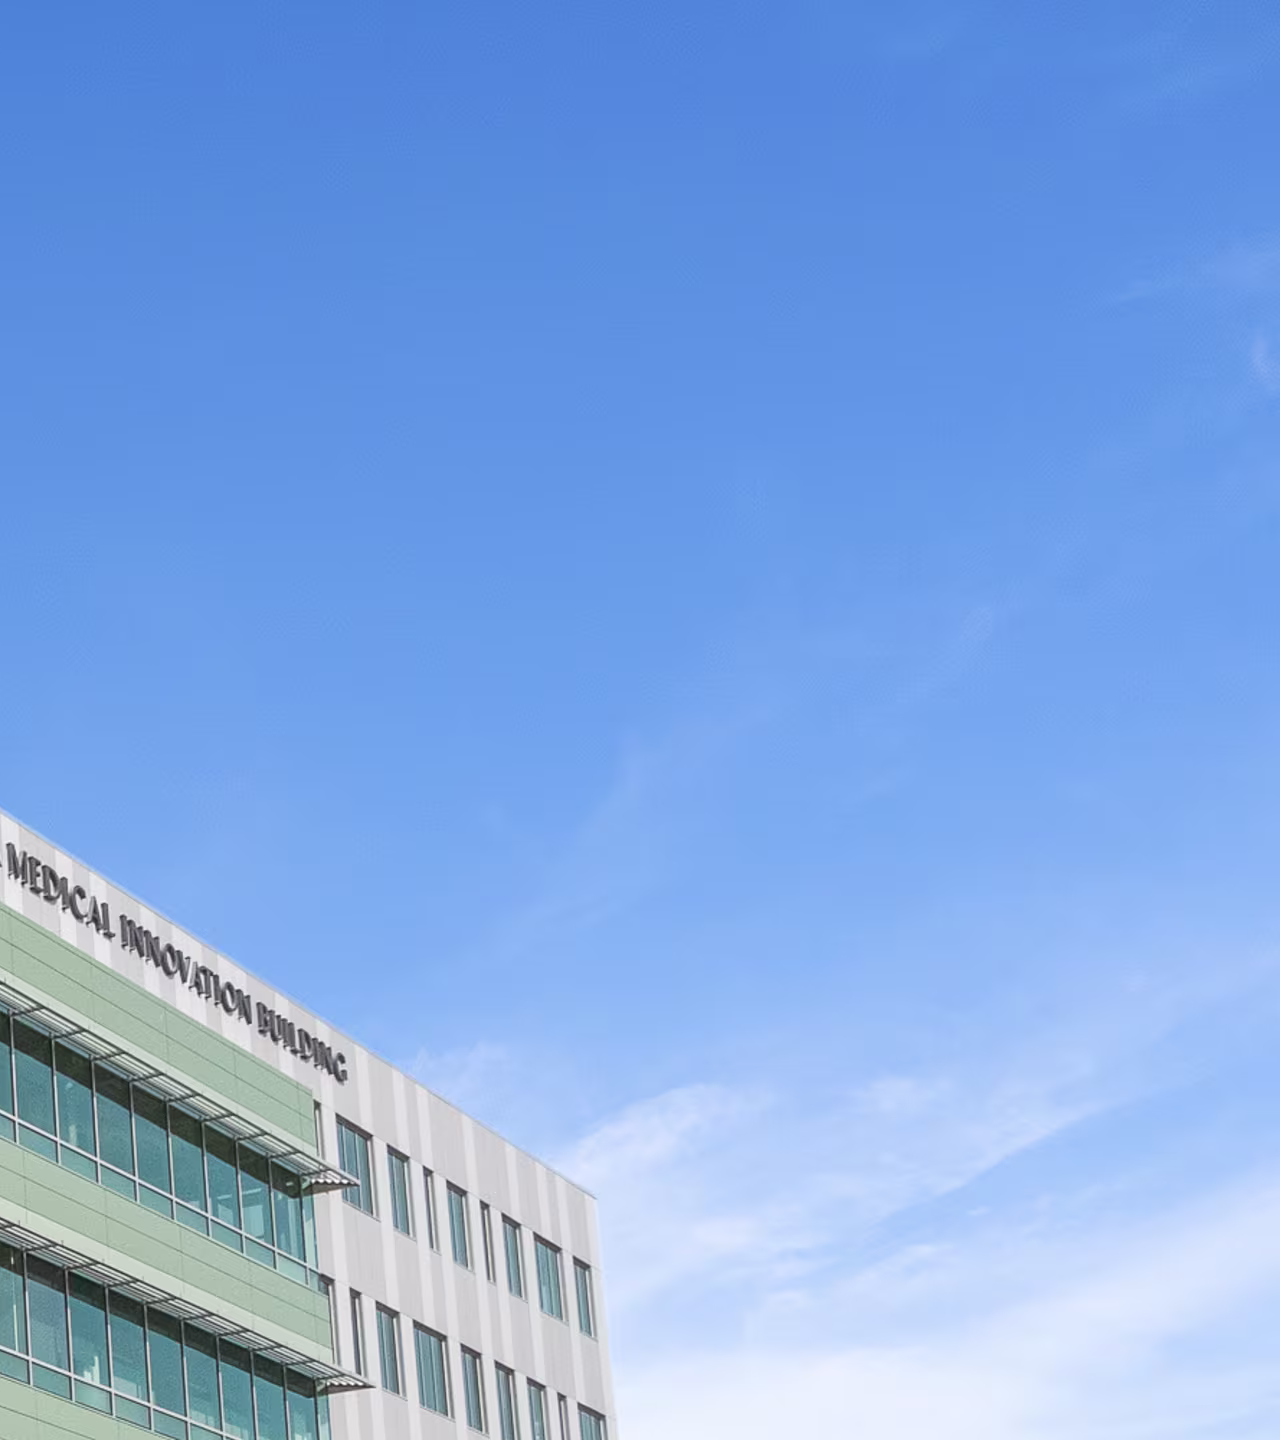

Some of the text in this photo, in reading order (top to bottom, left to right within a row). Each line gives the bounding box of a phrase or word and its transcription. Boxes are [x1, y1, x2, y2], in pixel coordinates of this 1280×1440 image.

[6, 842, 115, 940] MEDICAL
[119, 914, 253, 1025] INNOVATION
[256, 1002, 349, 1084] BUILDING
